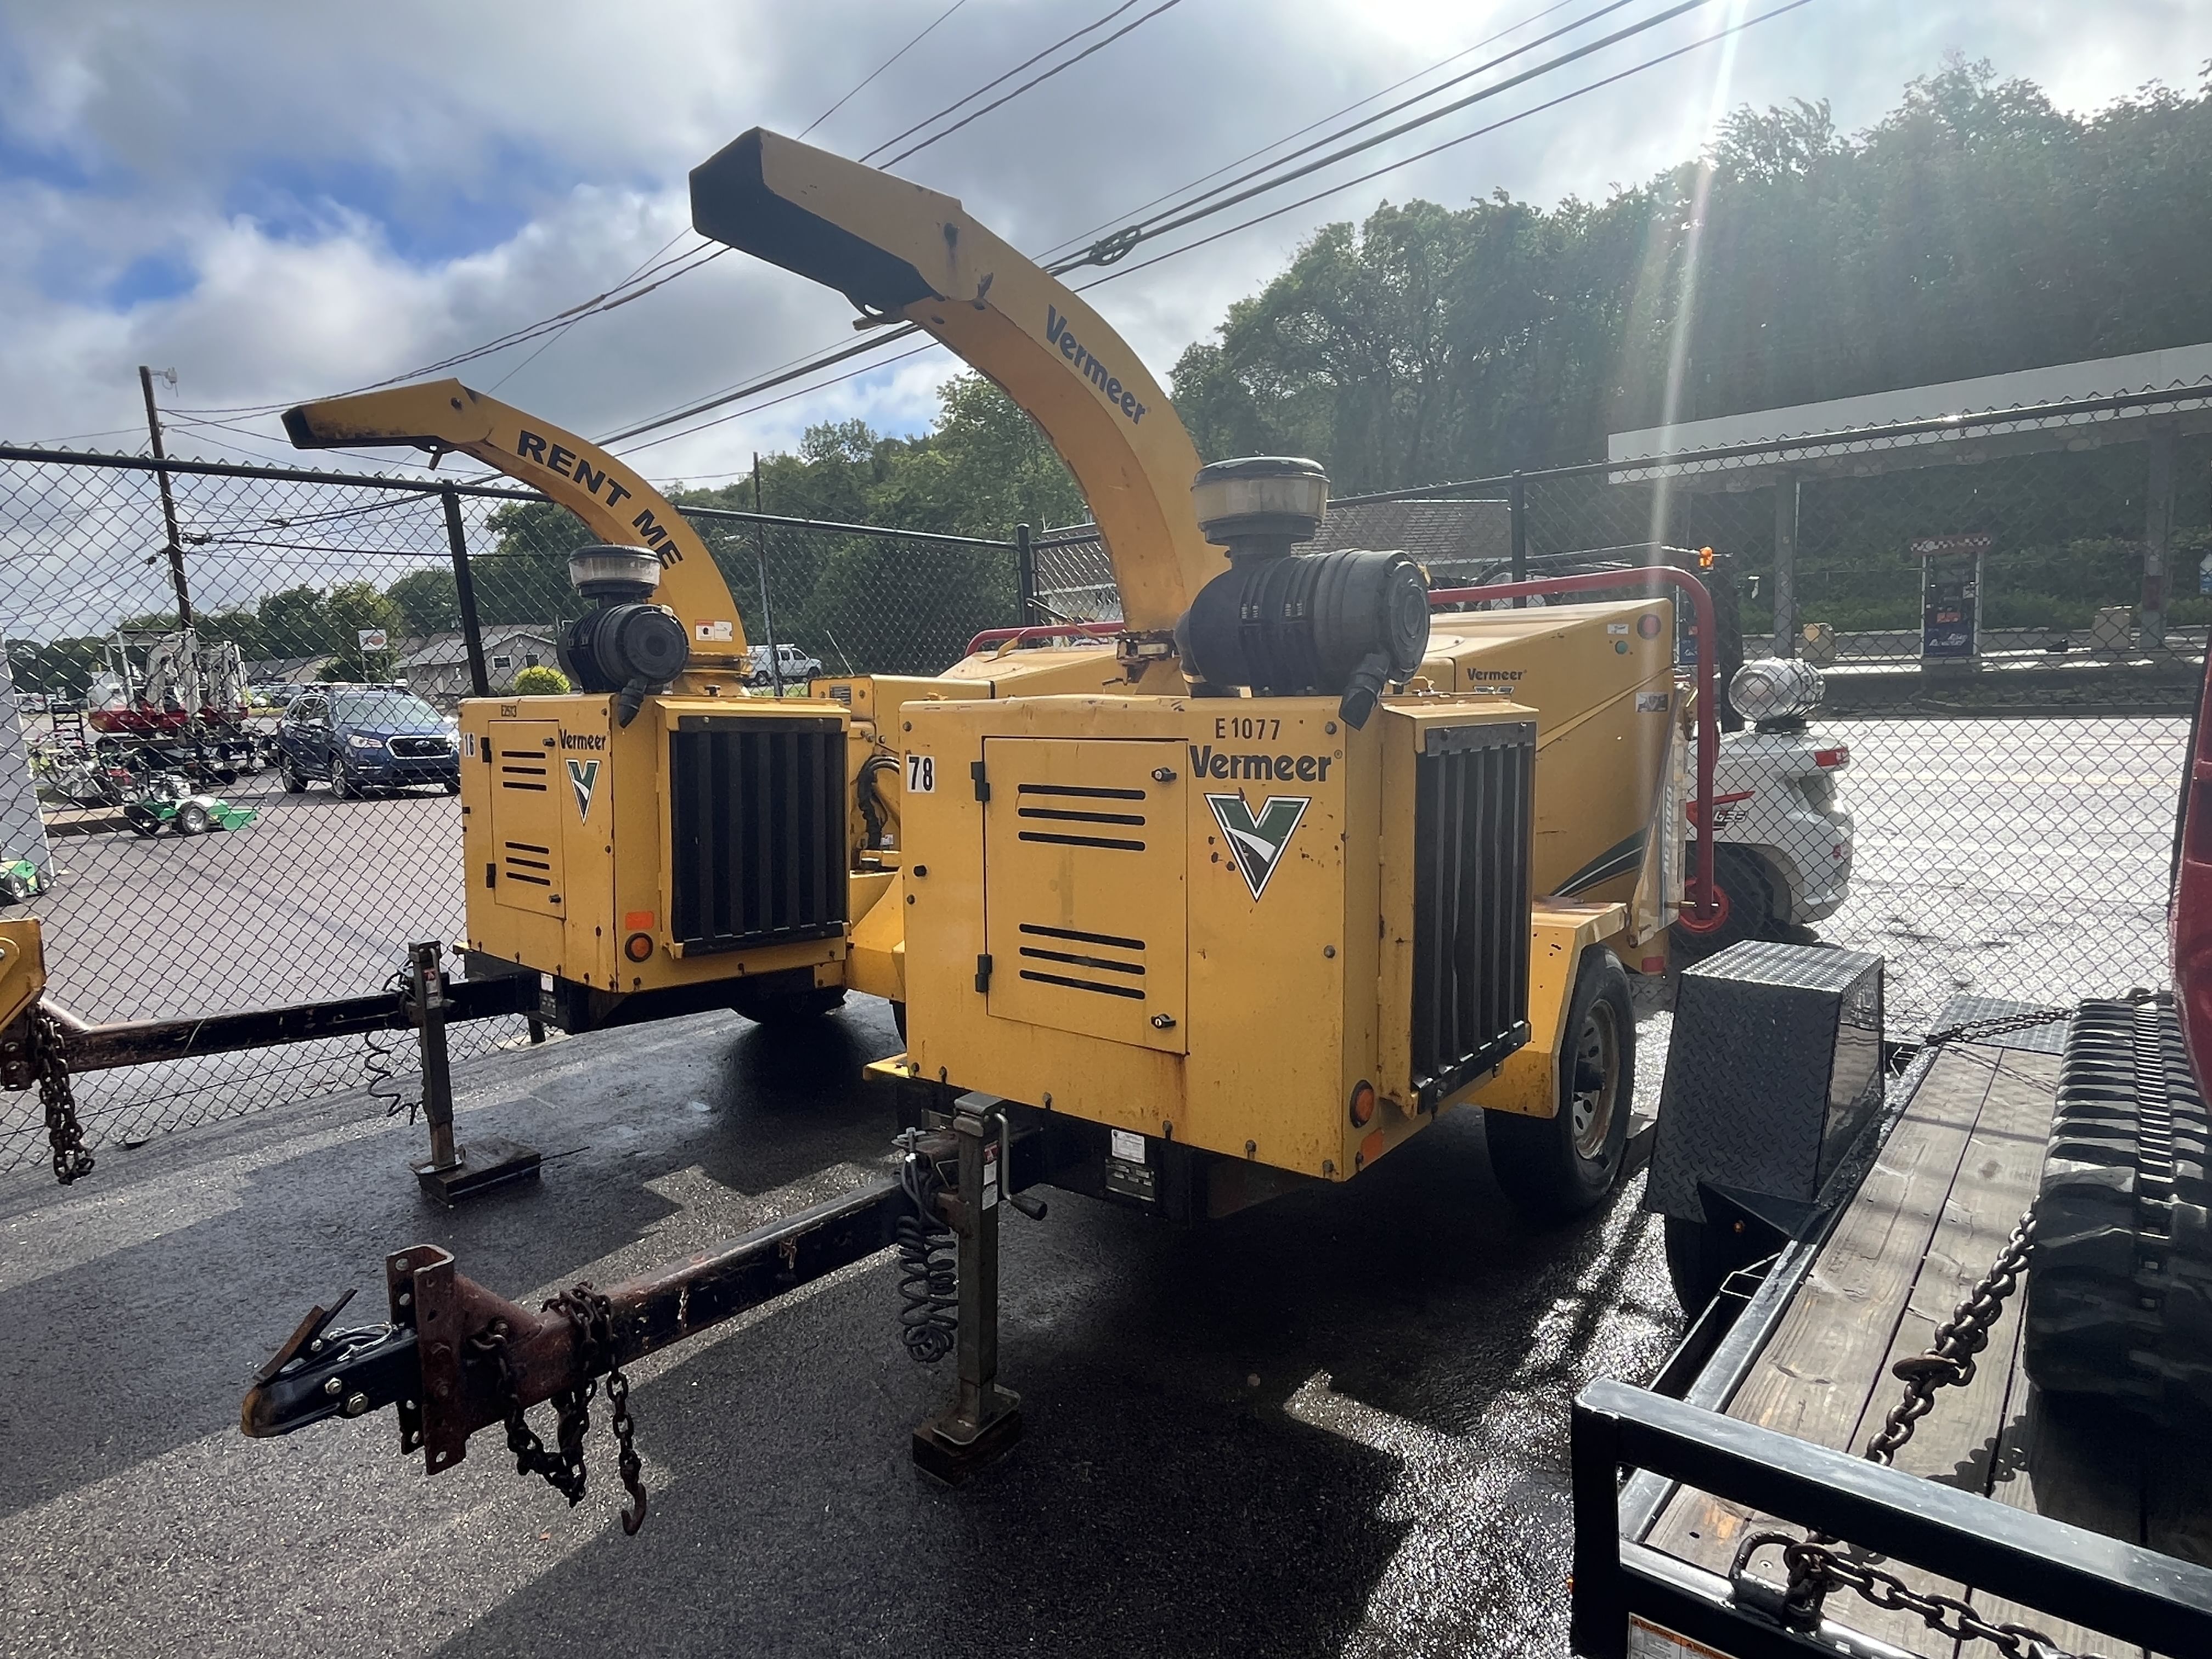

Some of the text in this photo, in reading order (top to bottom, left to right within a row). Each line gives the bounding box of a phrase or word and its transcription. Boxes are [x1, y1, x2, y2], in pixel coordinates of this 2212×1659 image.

[1046, 304, 1146, 425] Vermeer
[517, 430, 684, 571] RENT ME
[1467, 668, 1523, 680] Vermeer
[559, 729, 606, 751] Vermeer
[909, 756, 933, 791] 78
[1189, 745, 1332, 782] Vermeer
